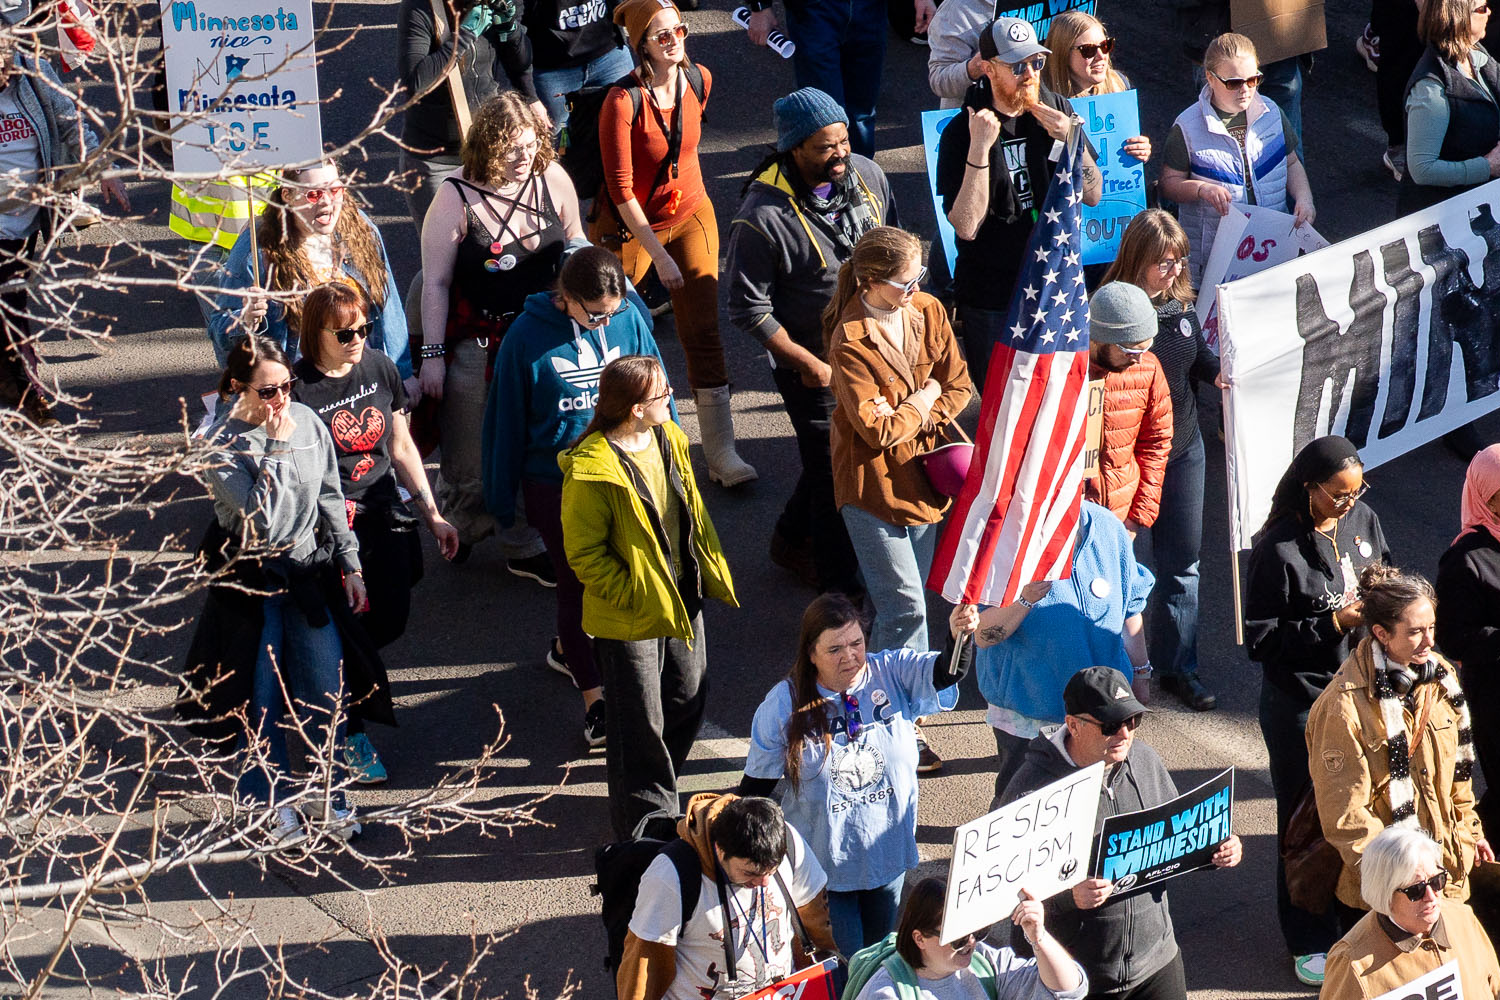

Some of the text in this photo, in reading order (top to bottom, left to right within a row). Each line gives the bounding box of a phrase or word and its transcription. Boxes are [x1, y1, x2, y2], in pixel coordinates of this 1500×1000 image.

[171, 0, 299, 32] Minnesota
[209, 34, 273, 50] nice
[177, 85, 297, 114] Minnesota
[860, 786, 895, 805] 1889
[962, 776, 1092, 866] RESIST
[1107, 785, 1230, 856] STAND WITH
[1102, 809, 1232, 883] MINNESOTA
[955, 831, 1073, 910] FASCISM
[1144, 861, 1181, 879] AFL-CIO
